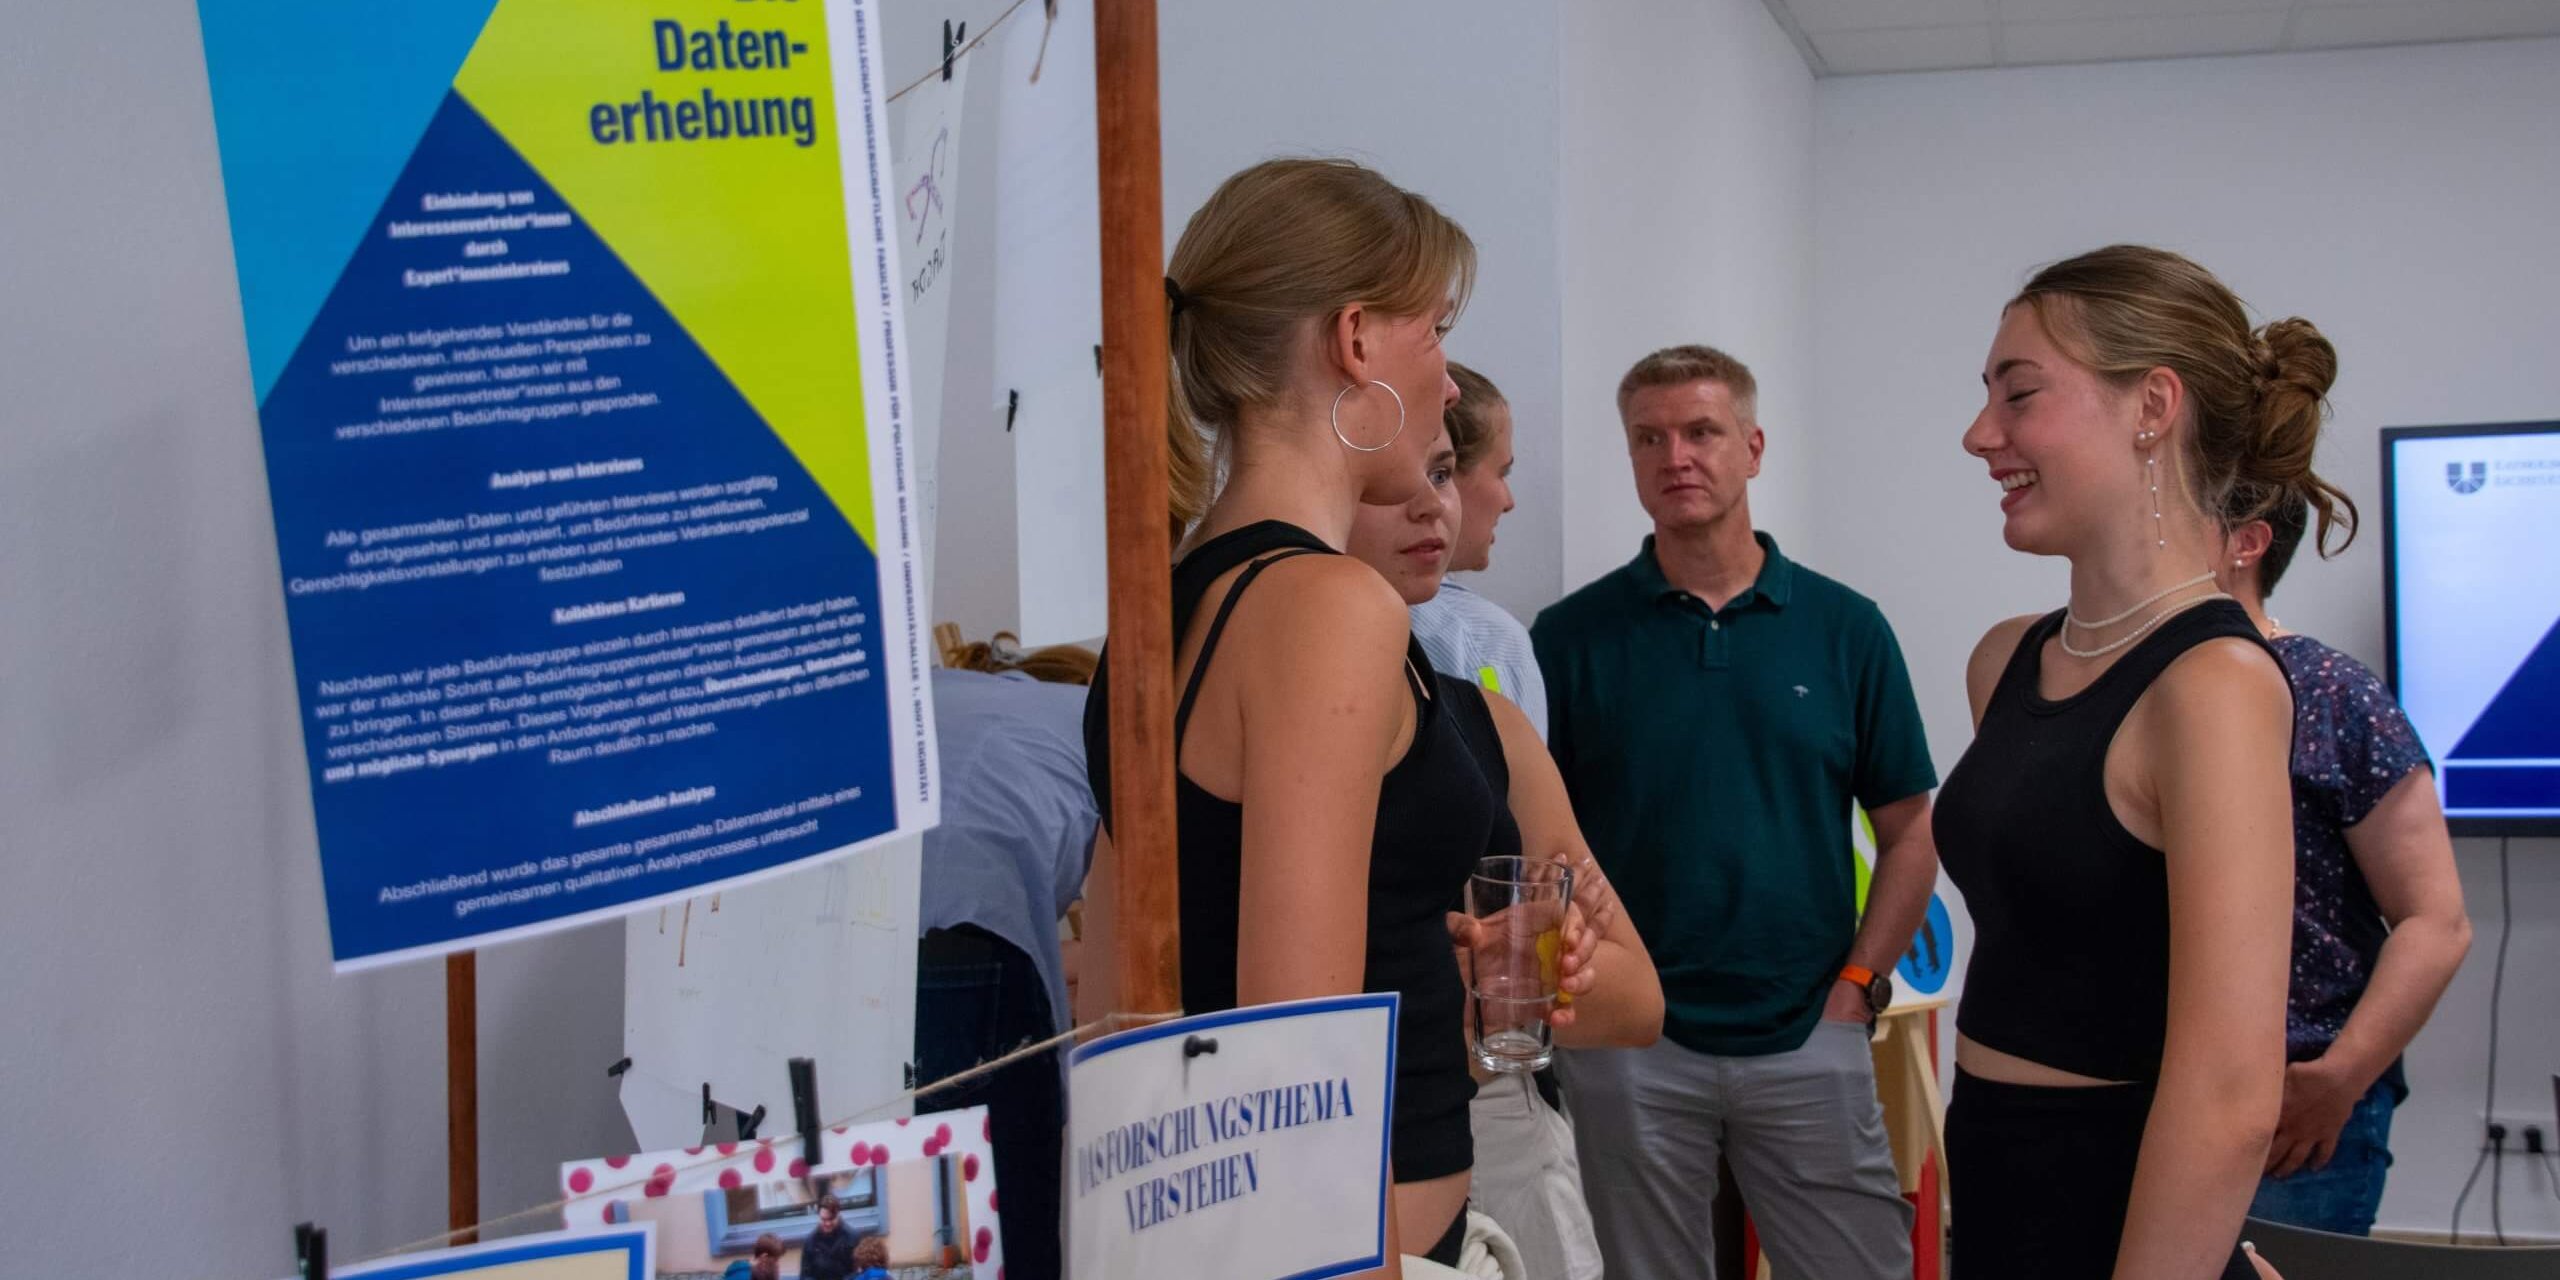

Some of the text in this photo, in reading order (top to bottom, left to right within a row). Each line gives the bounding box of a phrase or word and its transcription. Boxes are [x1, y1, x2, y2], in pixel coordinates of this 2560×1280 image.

[653, 20, 808, 72] Daten-
[589, 88, 816, 148] erhebung
[423, 192, 535, 210] Einbindung von
[463, 240, 508, 256] durch
[876, 248, 892, 307] FAKULTÄT
[347, 314, 633, 350] Um ein tiefgehendes Verständnis für die
[452, 344, 543, 361] individuellen
[543, 336, 632, 353] Perspektiven
[634, 335, 651, 345] zu
[882, 320, 897, 392] PROFESSUR
[493, 366, 540, 379] haben
[541, 364, 564, 374] wir
[565, 359, 588, 371] mit
[567, 381, 593, 392] aus
[594, 377, 622, 390] den
[336, 417, 450, 437] verschiedenen
[451, 403, 578, 425] Bedürfnisgruppen
[890, 396, 902, 420] FÜR
[490, 459, 644, 488] Analyse von Interviews
[892, 424, 907, 493] POLITISCHE
[326, 532, 359, 545] Alle
[361, 520, 465, 544] gesammelten
[466, 514, 513, 528] Daten
[515, 508, 543, 522] und
[545, 501, 611, 521] geführten
[612, 492, 678, 508] Interviews
[679, 485, 725, 499] werden
[348, 542, 459, 564] durchgesehen
[460, 536, 492, 549] und
[568, 524, 593, 535] um
[593, 513, 671, 532] Bedürfnisse
[672, 511, 690, 521] zu
[898, 497, 911, 549] BILDUNG
[290, 557, 504, 593] Gerechtigkeitsvorstellungen
[506, 555, 523, 565] zu
[525, 545, 586, 562] erheben
[587, 539, 613, 553] und
[615, 532, 679, 549] konkretes
[538, 560, 624, 580] festzuhalten
[553, 592, 686, 623] Kollektives Kartieren
[903, 561, 921, 681] UNIVERSITÄTSALLEE
[316, 705, 346, 717] war
[350, 700, 377, 712] der
[380, 690, 441, 707] nächste
[445, 681, 495, 698] Schritt
[496, 677, 523, 689] alle
[733, 628, 800, 650] gemeinsam
[800, 625, 815, 635] an
[319, 676, 398, 694] Nachdem
[400, 672, 424, 683] wir
[427, 665, 462, 682] jede
[463, 648, 581, 674] Bedürfnisgruppe
[583, 638, 632, 655] einzeln
[632, 631, 670, 646] durch
[671, 621, 734, 639] Interviews
[787, 602, 826, 618] befragt
[329, 726, 350, 736] zu
[420, 711, 437, 722] In
[439, 704, 486, 719] dieser
[489, 695, 538, 711] Runde
[540, 676, 624, 703] ermöglichen
[625, 677, 646, 688] wir
[647, 670, 683, 684] einen
[683, 660, 733, 677] direkten
[733, 647, 793, 667] Austausch
[795, 638, 843, 656] zwischen
[843, 634, 862, 645] den
[324, 764, 356, 781] und
[357, 754, 426, 776] mögliche
[427, 743, 499, 764] Synergien
[500, 741, 516, 750] in
[517, 736, 547, 748] den
[548, 715, 647, 742] Anforderungen
[648, 709, 673, 724] und
[674, 691, 775, 718] Wahrnehmungen
[776, 685, 792, 700] an
[794, 683, 815, 695] den
[327, 732, 443, 758] verschiedenen
[517, 711, 569, 727] Dieses
[570, 698, 635, 718] Vorgehen
[636, 691, 669, 706] dient
[548, 747, 594, 762] Raum
[595, 736, 647, 755] deutlich
[648, 734, 665, 744] zu
[916, 741, 931, 804] EICHSTÄTT
[573, 786, 717, 826] Abschließende Analyse
[379, 871, 488, 901] Abschließend
[491, 863, 539, 880] wurde
[541, 857, 569, 871] das
[571, 844, 633, 866] gesamte
[634, 825, 714, 852] gesammelte
[715, 804, 797, 833] Datenmaterial
[797, 795, 834, 812] mittels
[455, 820, 820, 915] gemeinsamen qualitativen Analyseprozesses untersucht
[1106, 1077, 1354, 1180] FORSCHUNGSTHEMA
[1125, 1149, 1260, 1235] VERSTEHEN
